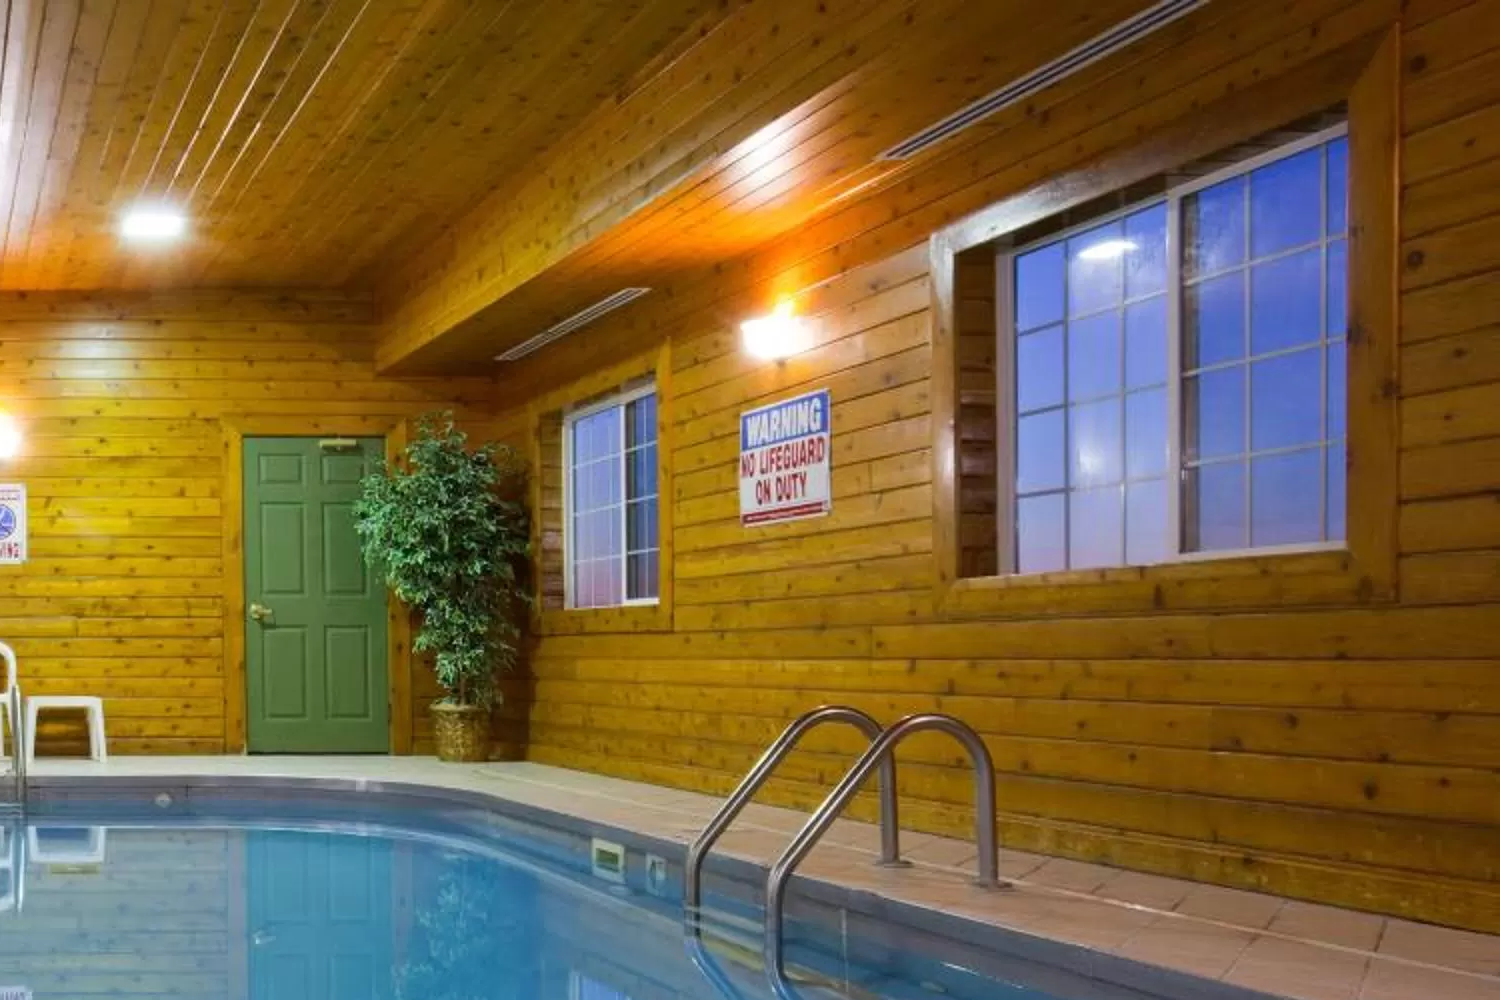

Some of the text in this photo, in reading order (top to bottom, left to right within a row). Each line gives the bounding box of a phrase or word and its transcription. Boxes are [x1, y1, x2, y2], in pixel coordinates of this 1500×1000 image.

[746, 398, 822, 447] WARNING
[741, 436, 825, 478] NO LIFEGUARD
[755, 472, 807, 505] ON DUTY
